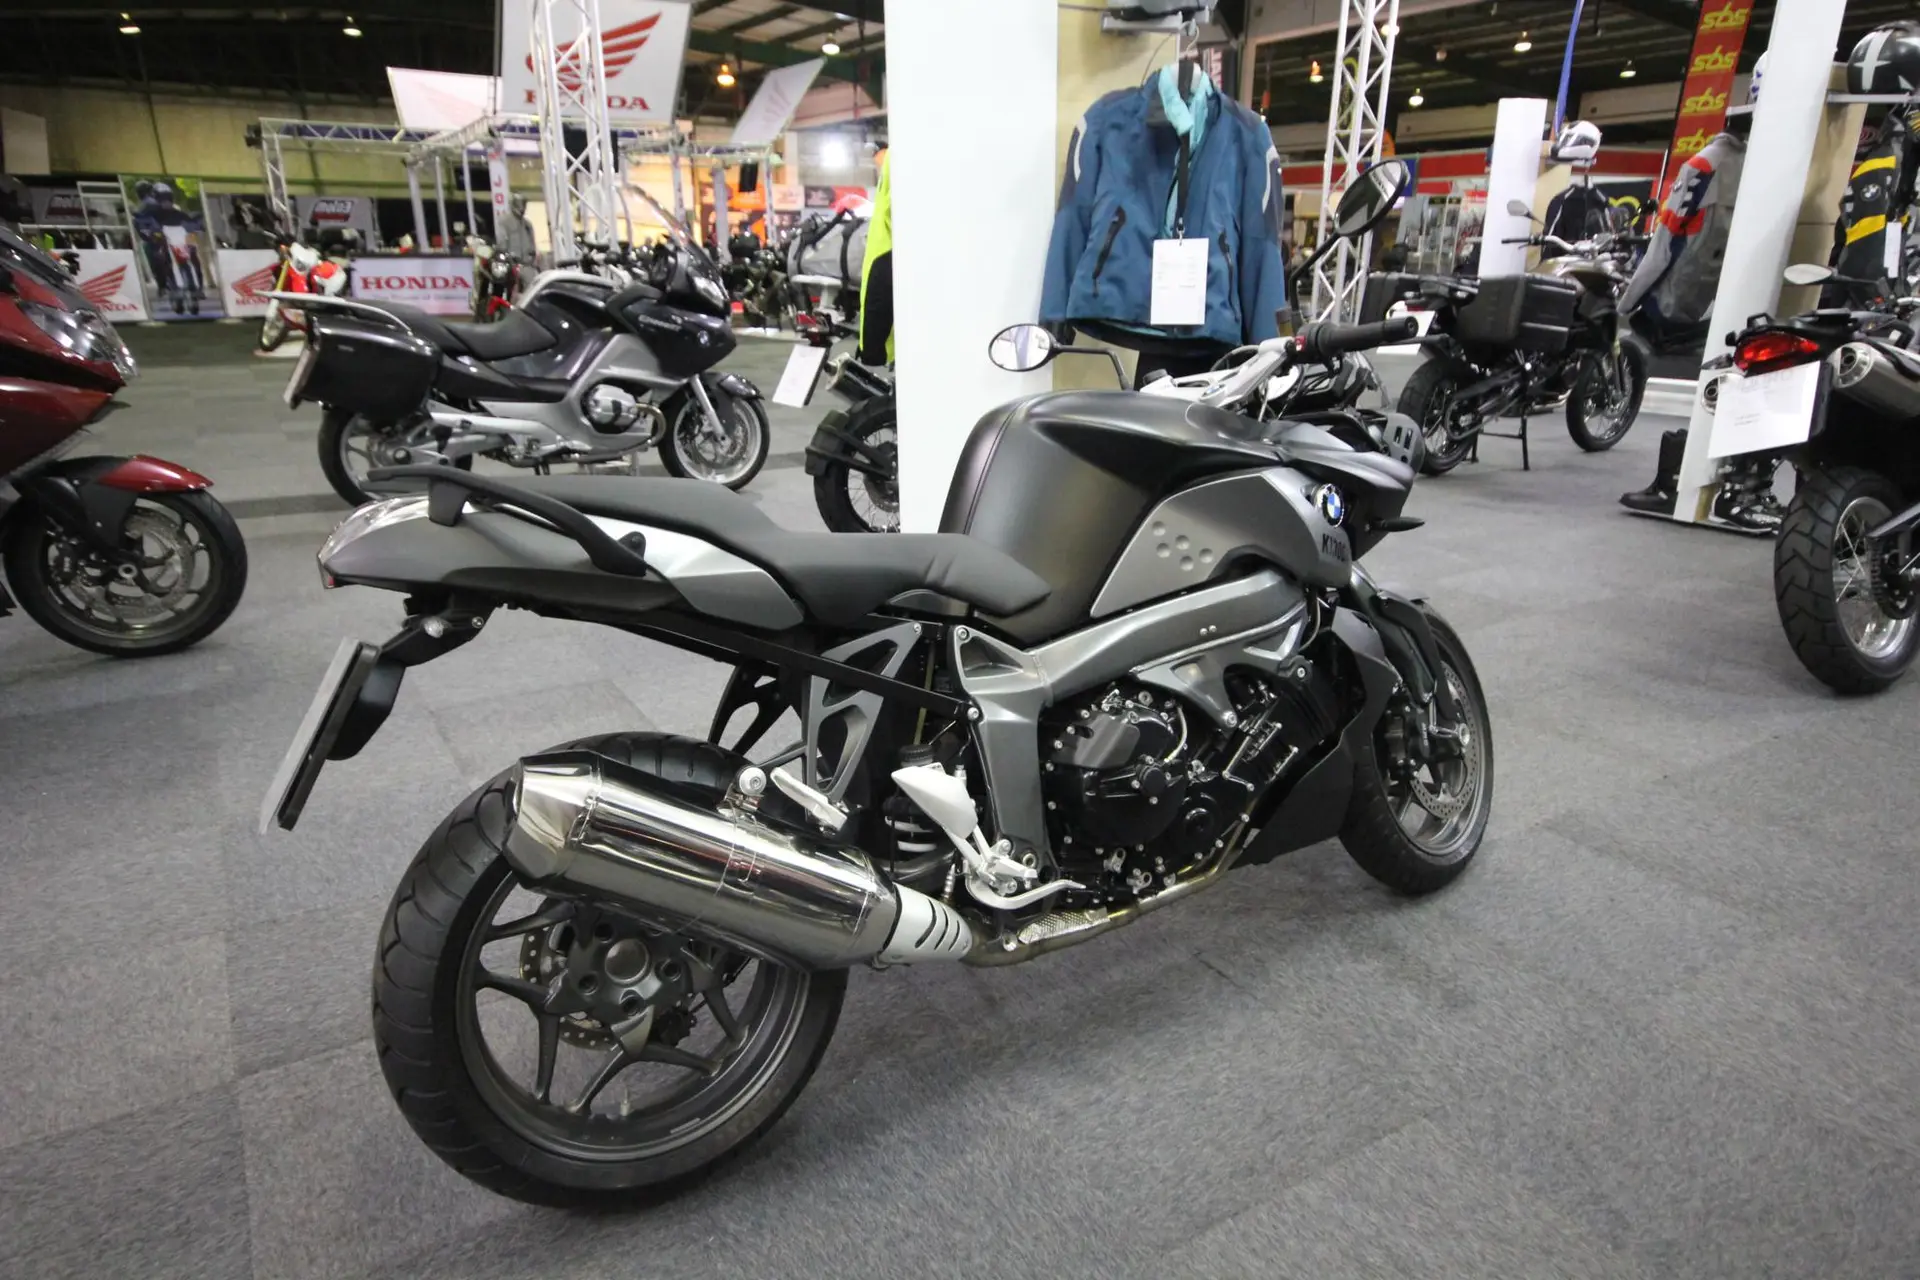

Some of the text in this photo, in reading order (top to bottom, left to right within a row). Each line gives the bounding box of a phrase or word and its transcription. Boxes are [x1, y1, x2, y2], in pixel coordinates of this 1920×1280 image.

[1702, 2, 1748, 29] sbs
[1692, 45, 1737, 72] sbs
[1683, 87, 1727, 113] sbs
[360, 275, 472, 290] HONDA
